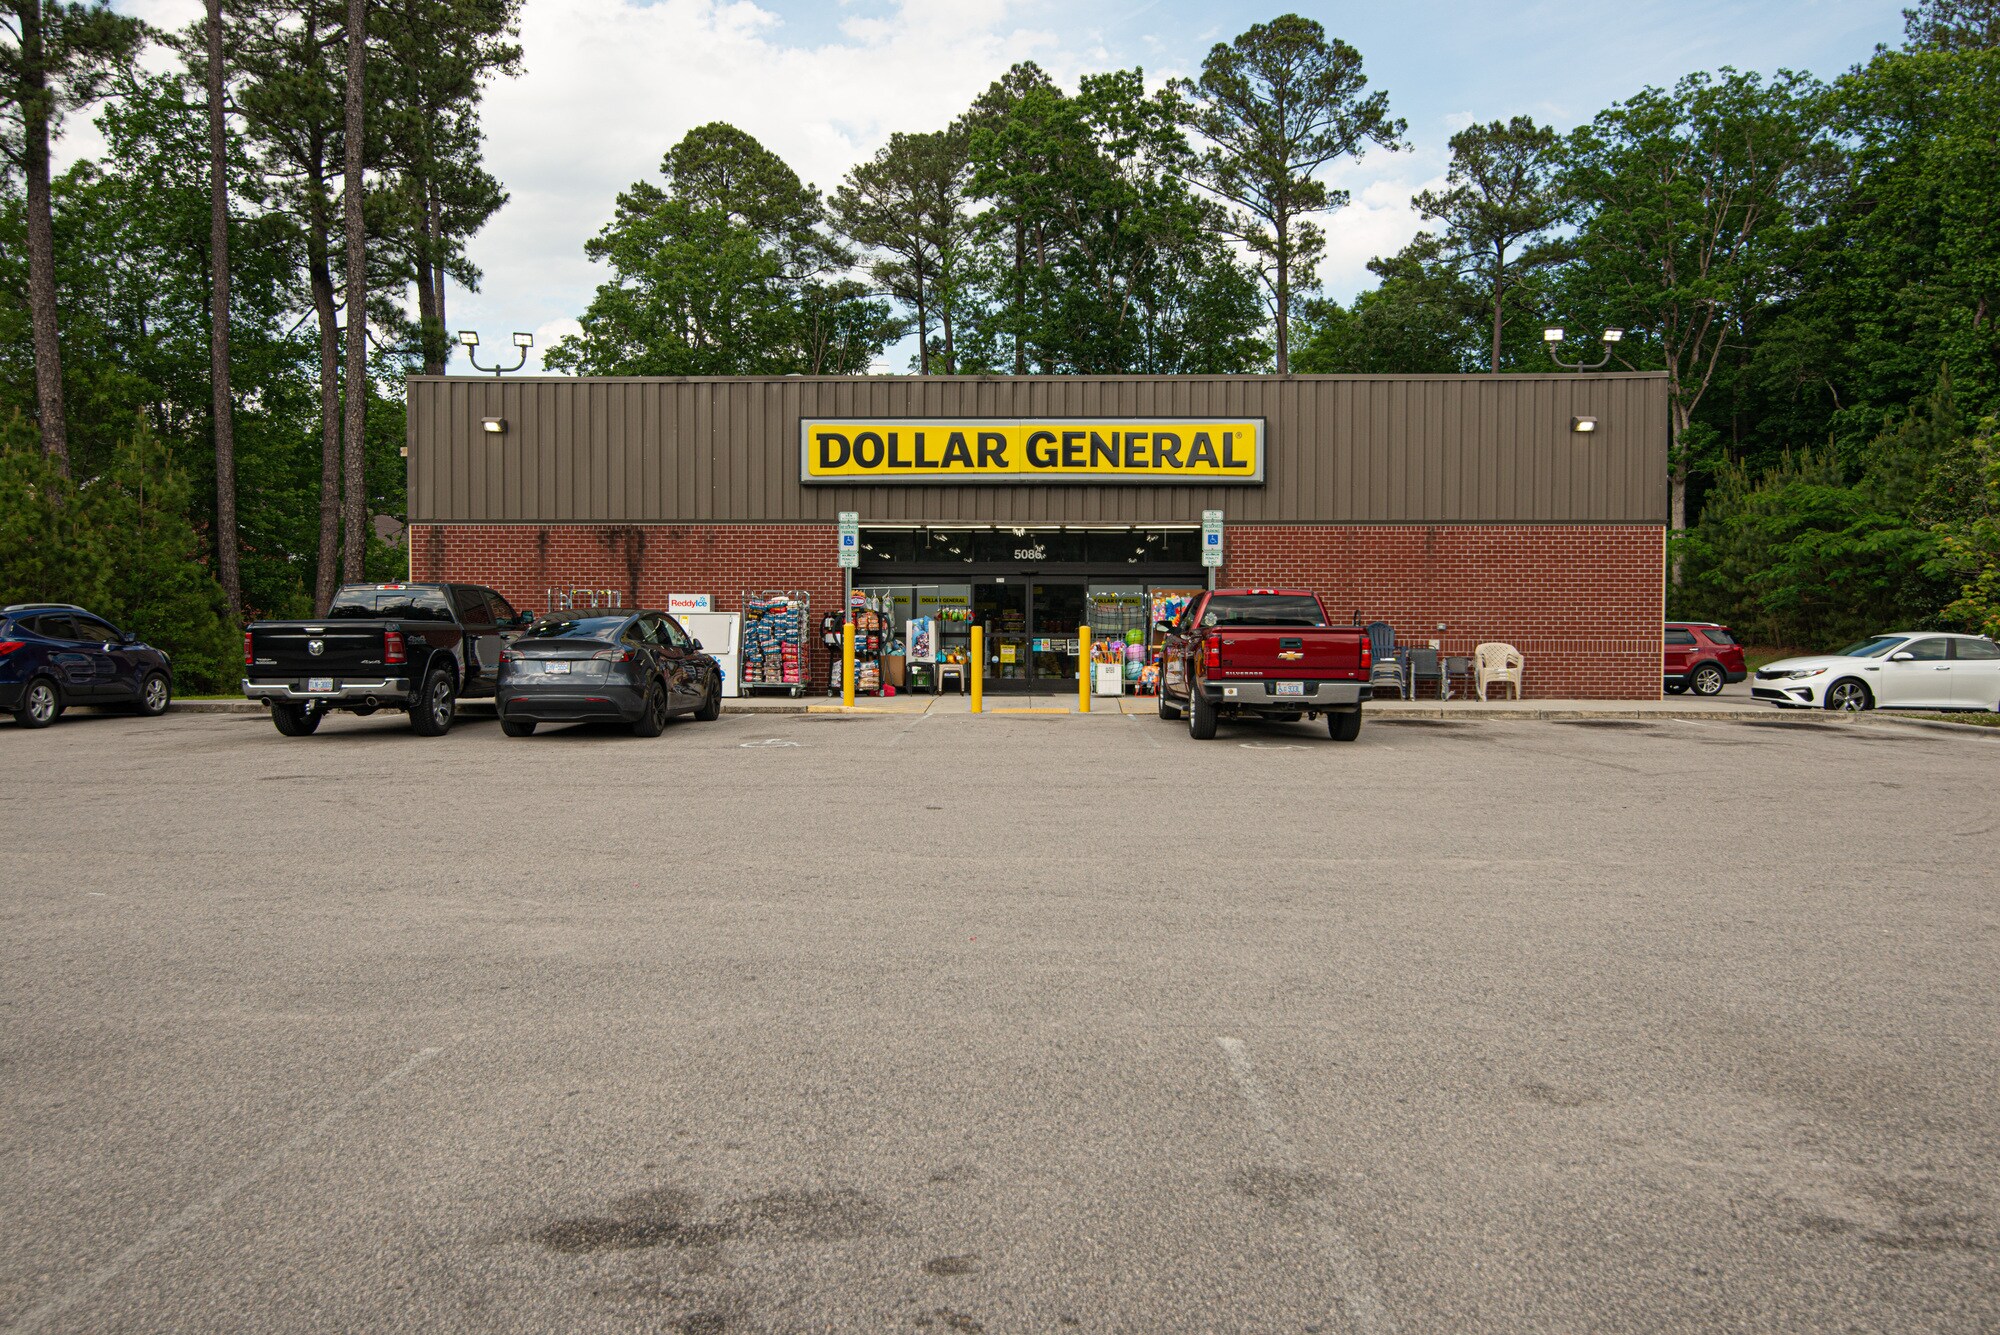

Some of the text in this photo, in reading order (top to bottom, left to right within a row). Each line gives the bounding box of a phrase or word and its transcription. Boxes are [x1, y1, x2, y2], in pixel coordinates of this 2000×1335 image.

[816, 431, 1247, 468] DOLLAR GENERAL
[1014, 549, 1041, 559] 5086
